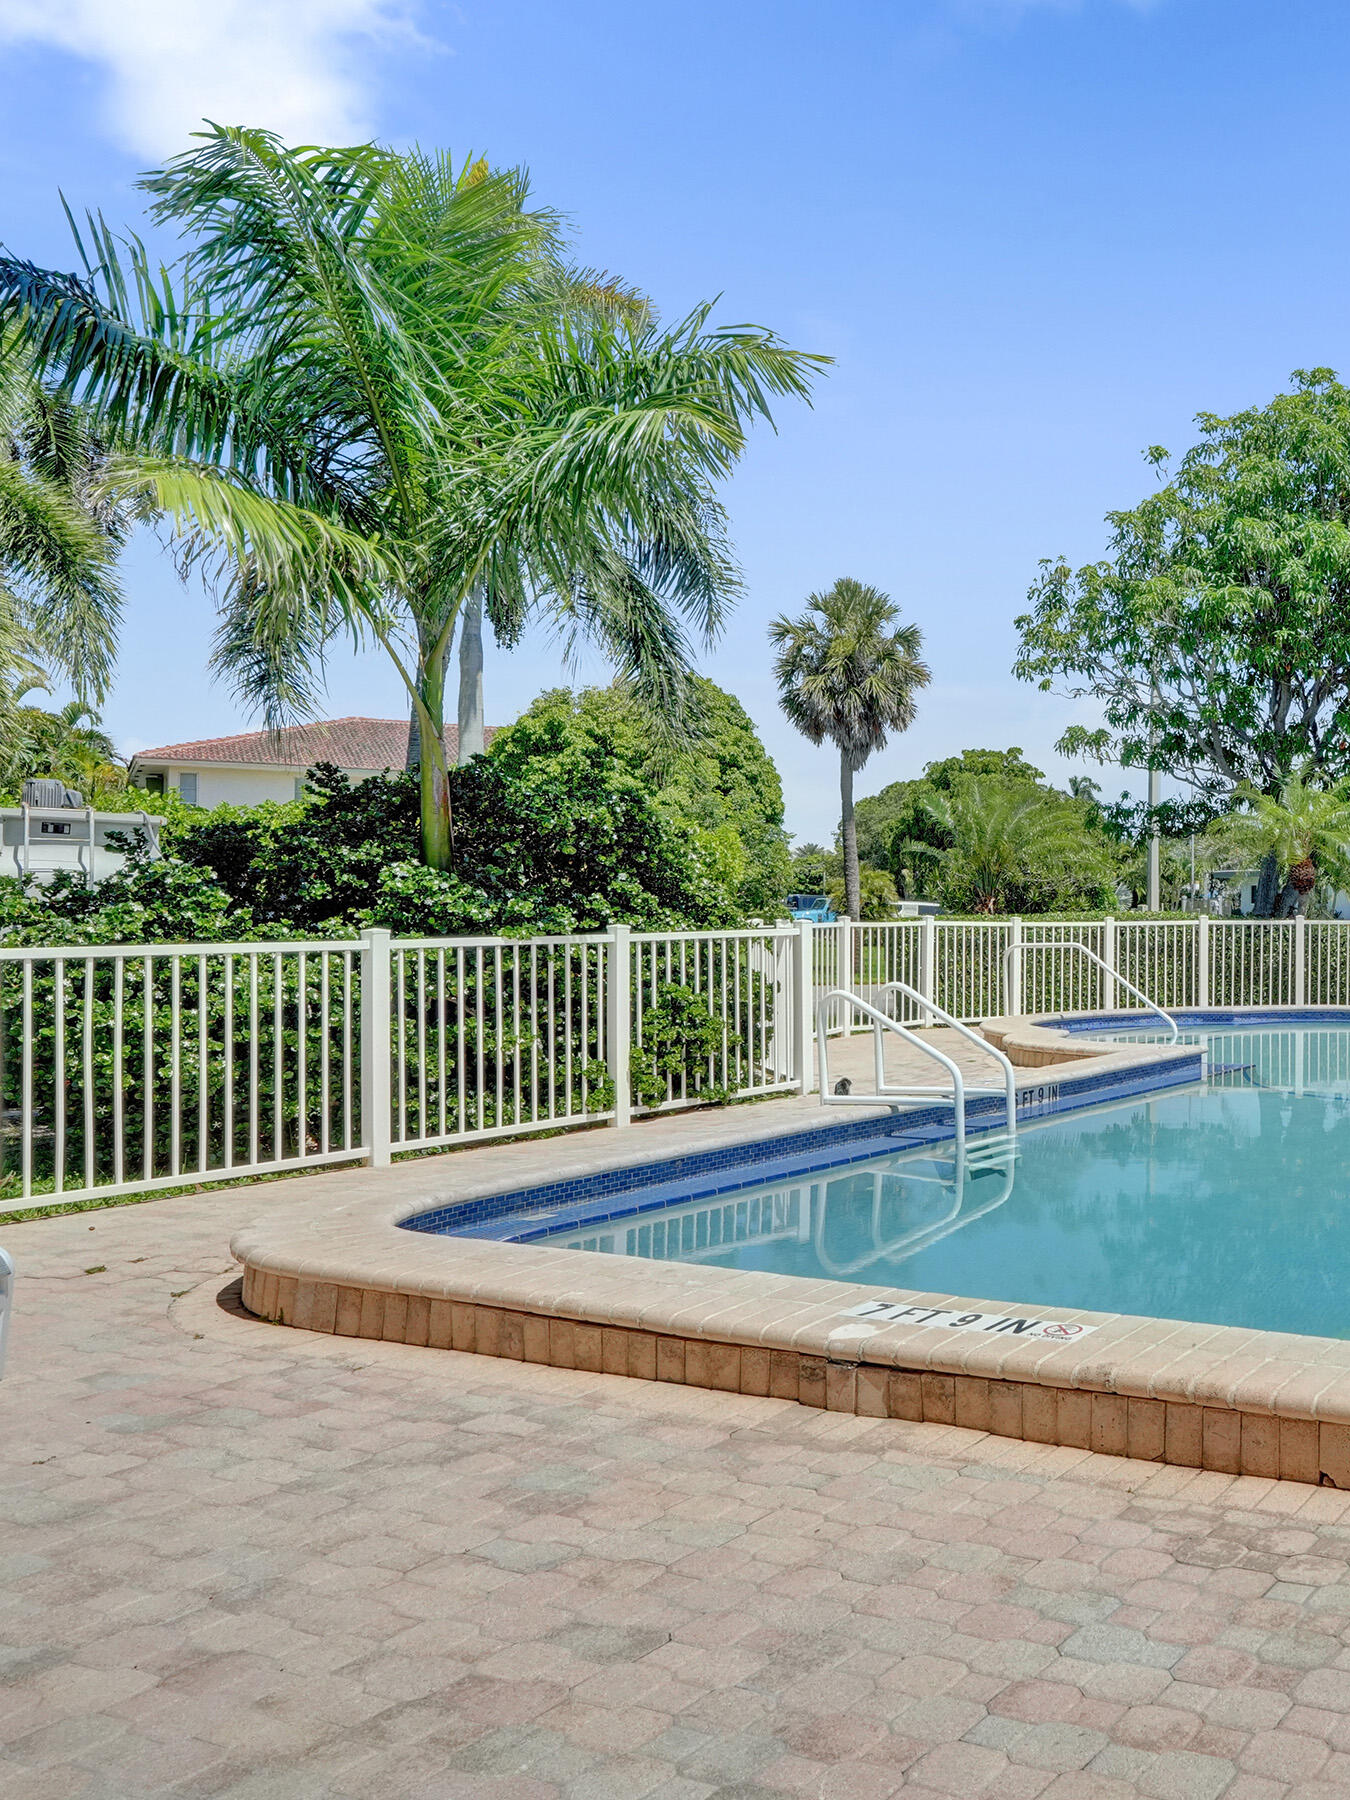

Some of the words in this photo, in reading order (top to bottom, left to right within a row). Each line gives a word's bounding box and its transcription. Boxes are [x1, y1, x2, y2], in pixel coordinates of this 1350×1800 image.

[1022, 1090, 1034, 1107] FT
[1038, 1087, 1044, 1103] 9
[1048, 1085, 1058, 1101] IN
[858, 1303, 895, 1316] 7
[888, 1307, 953, 1324] FT
[949, 1314, 983, 1327] 9
[983, 1317, 1042, 1334] IN
